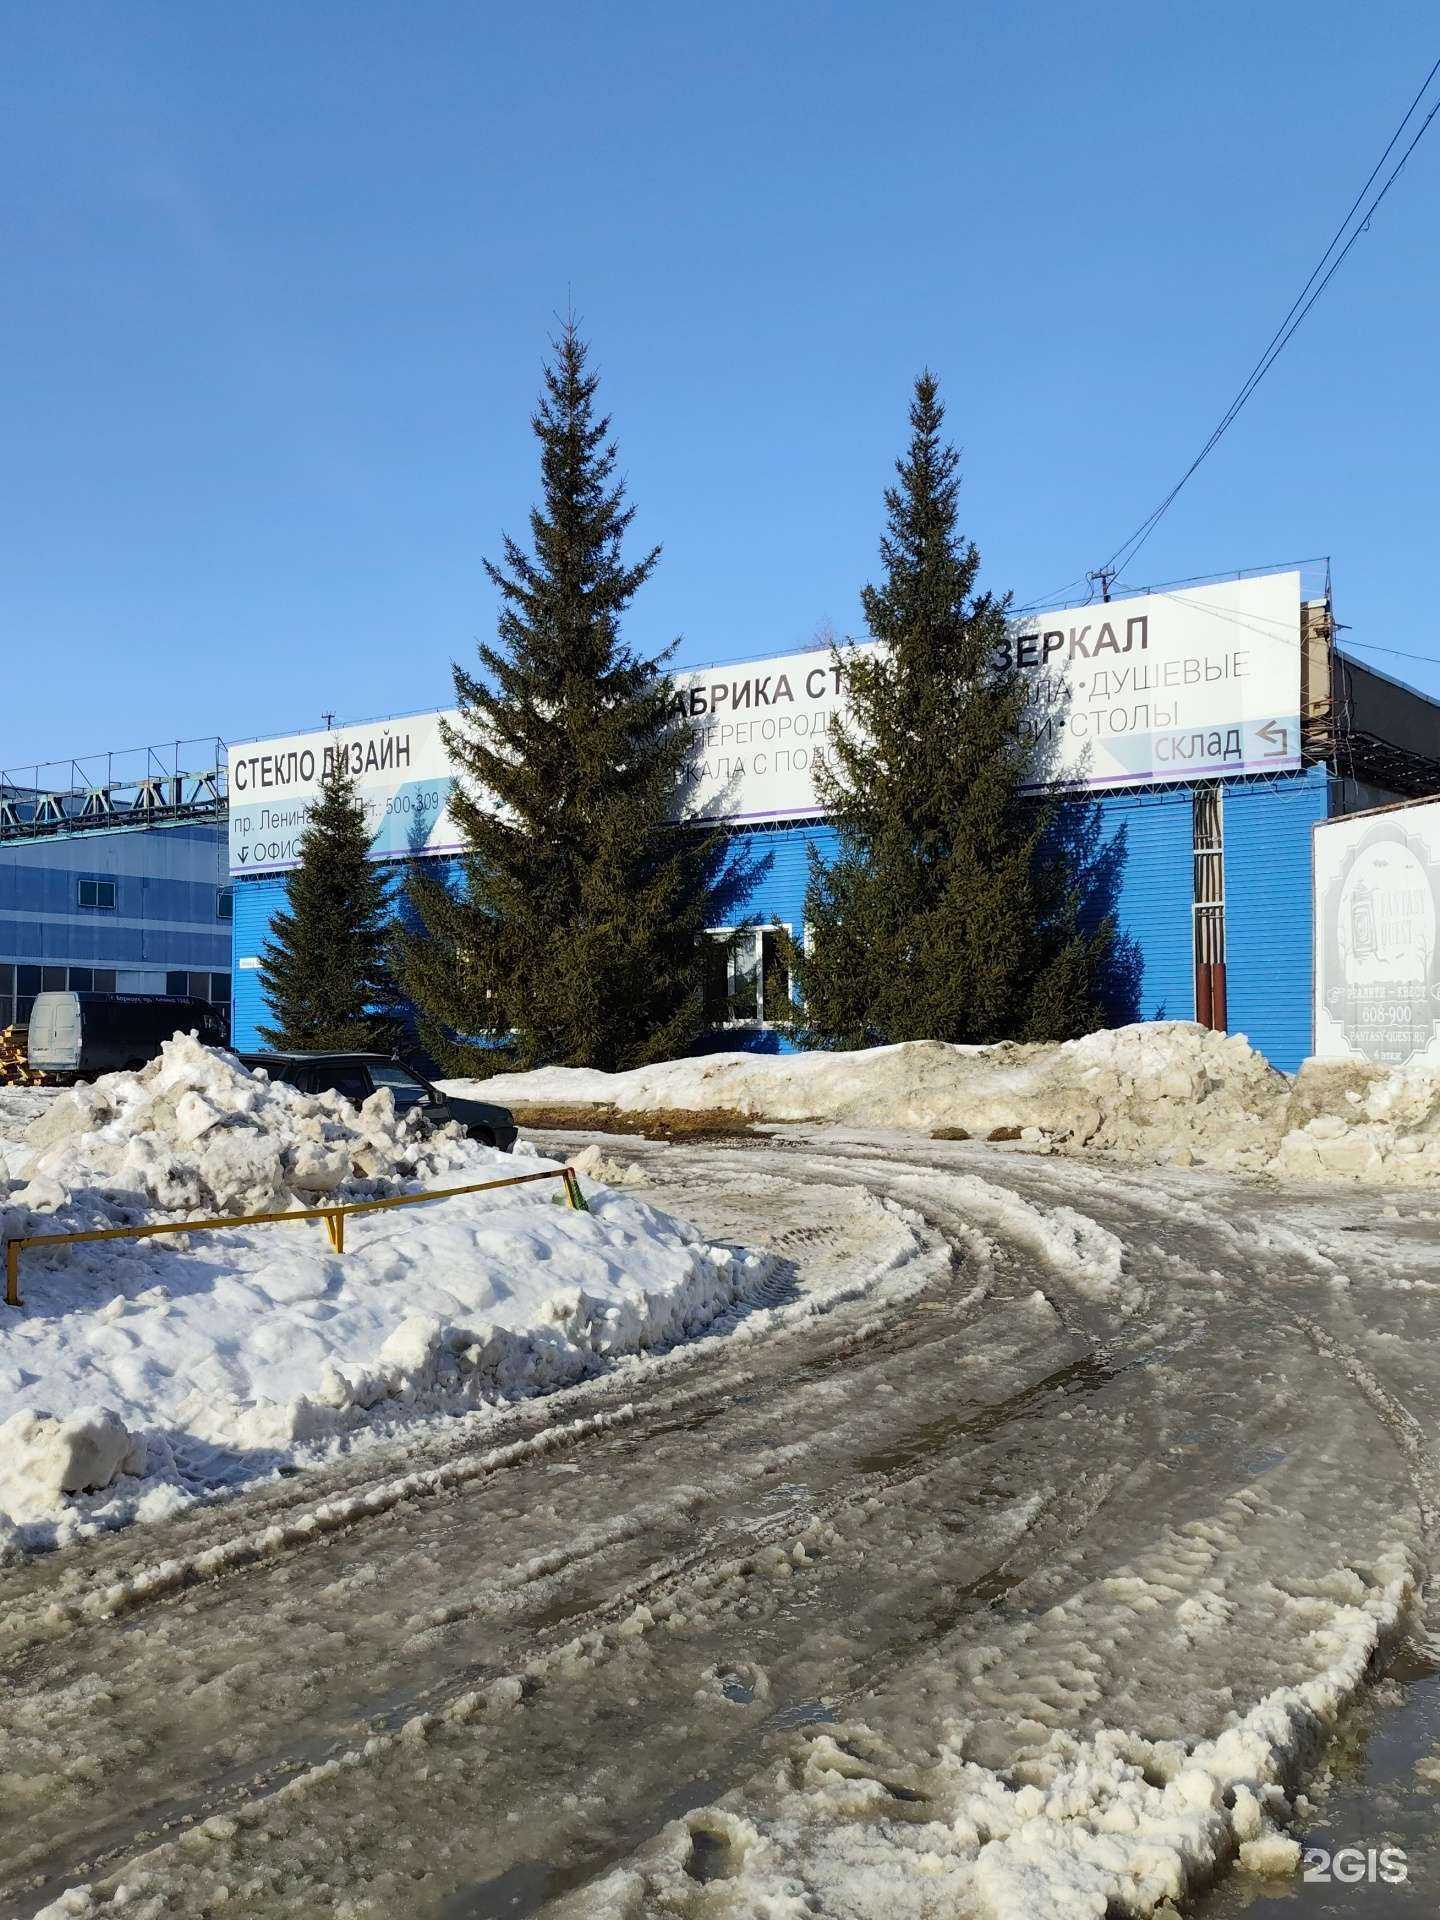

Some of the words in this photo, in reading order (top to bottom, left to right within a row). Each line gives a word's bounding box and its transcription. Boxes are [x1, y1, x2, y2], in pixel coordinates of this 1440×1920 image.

[664, 674, 794, 719] АБРИКА
[990, 615, 1149, 673] ЗЕРКАЛ
[1088, 650, 1251, 702] ДУШЕВЫЕ
[1070, 701, 1180, 738] СТОЛЫ
[234, 749, 315, 791] СТЕКЛО
[753, 753, 767, 775] С
[234, 816, 255, 836] пр.
[385, 791, 439, 815] 500-309
[253, 836, 302, 862] ОФИС
